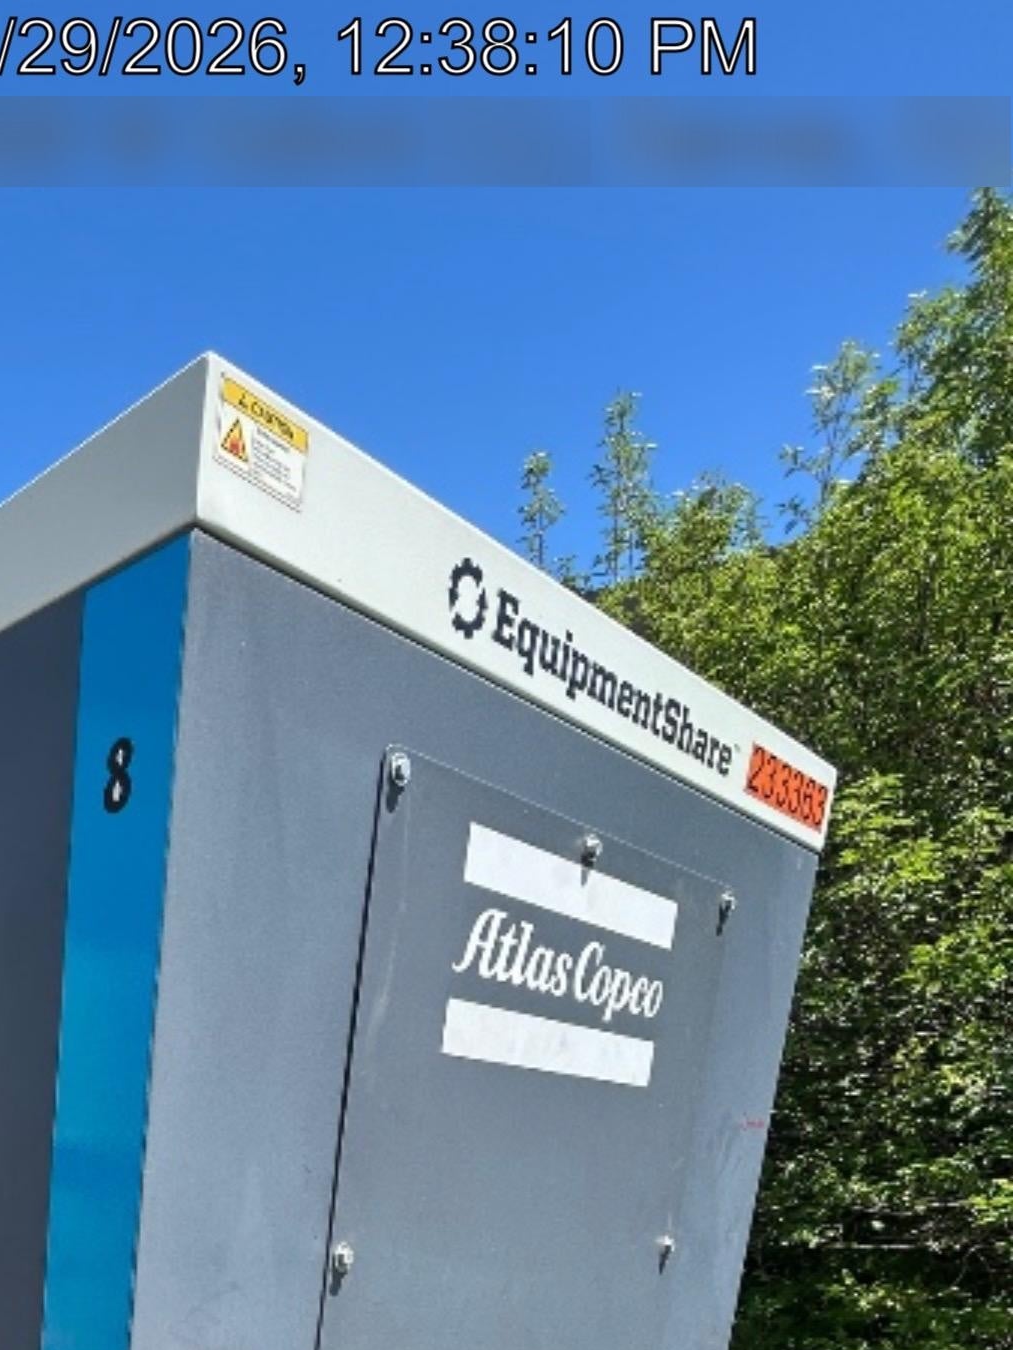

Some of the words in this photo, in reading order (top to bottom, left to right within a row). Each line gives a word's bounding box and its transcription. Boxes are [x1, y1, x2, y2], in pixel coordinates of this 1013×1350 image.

[491, 587, 733, 777] EquipmentShare
[103, 737, 134, 813] 8
[451, 908, 573, 997] Atlas
[574, 941, 664, 1022] Copco
